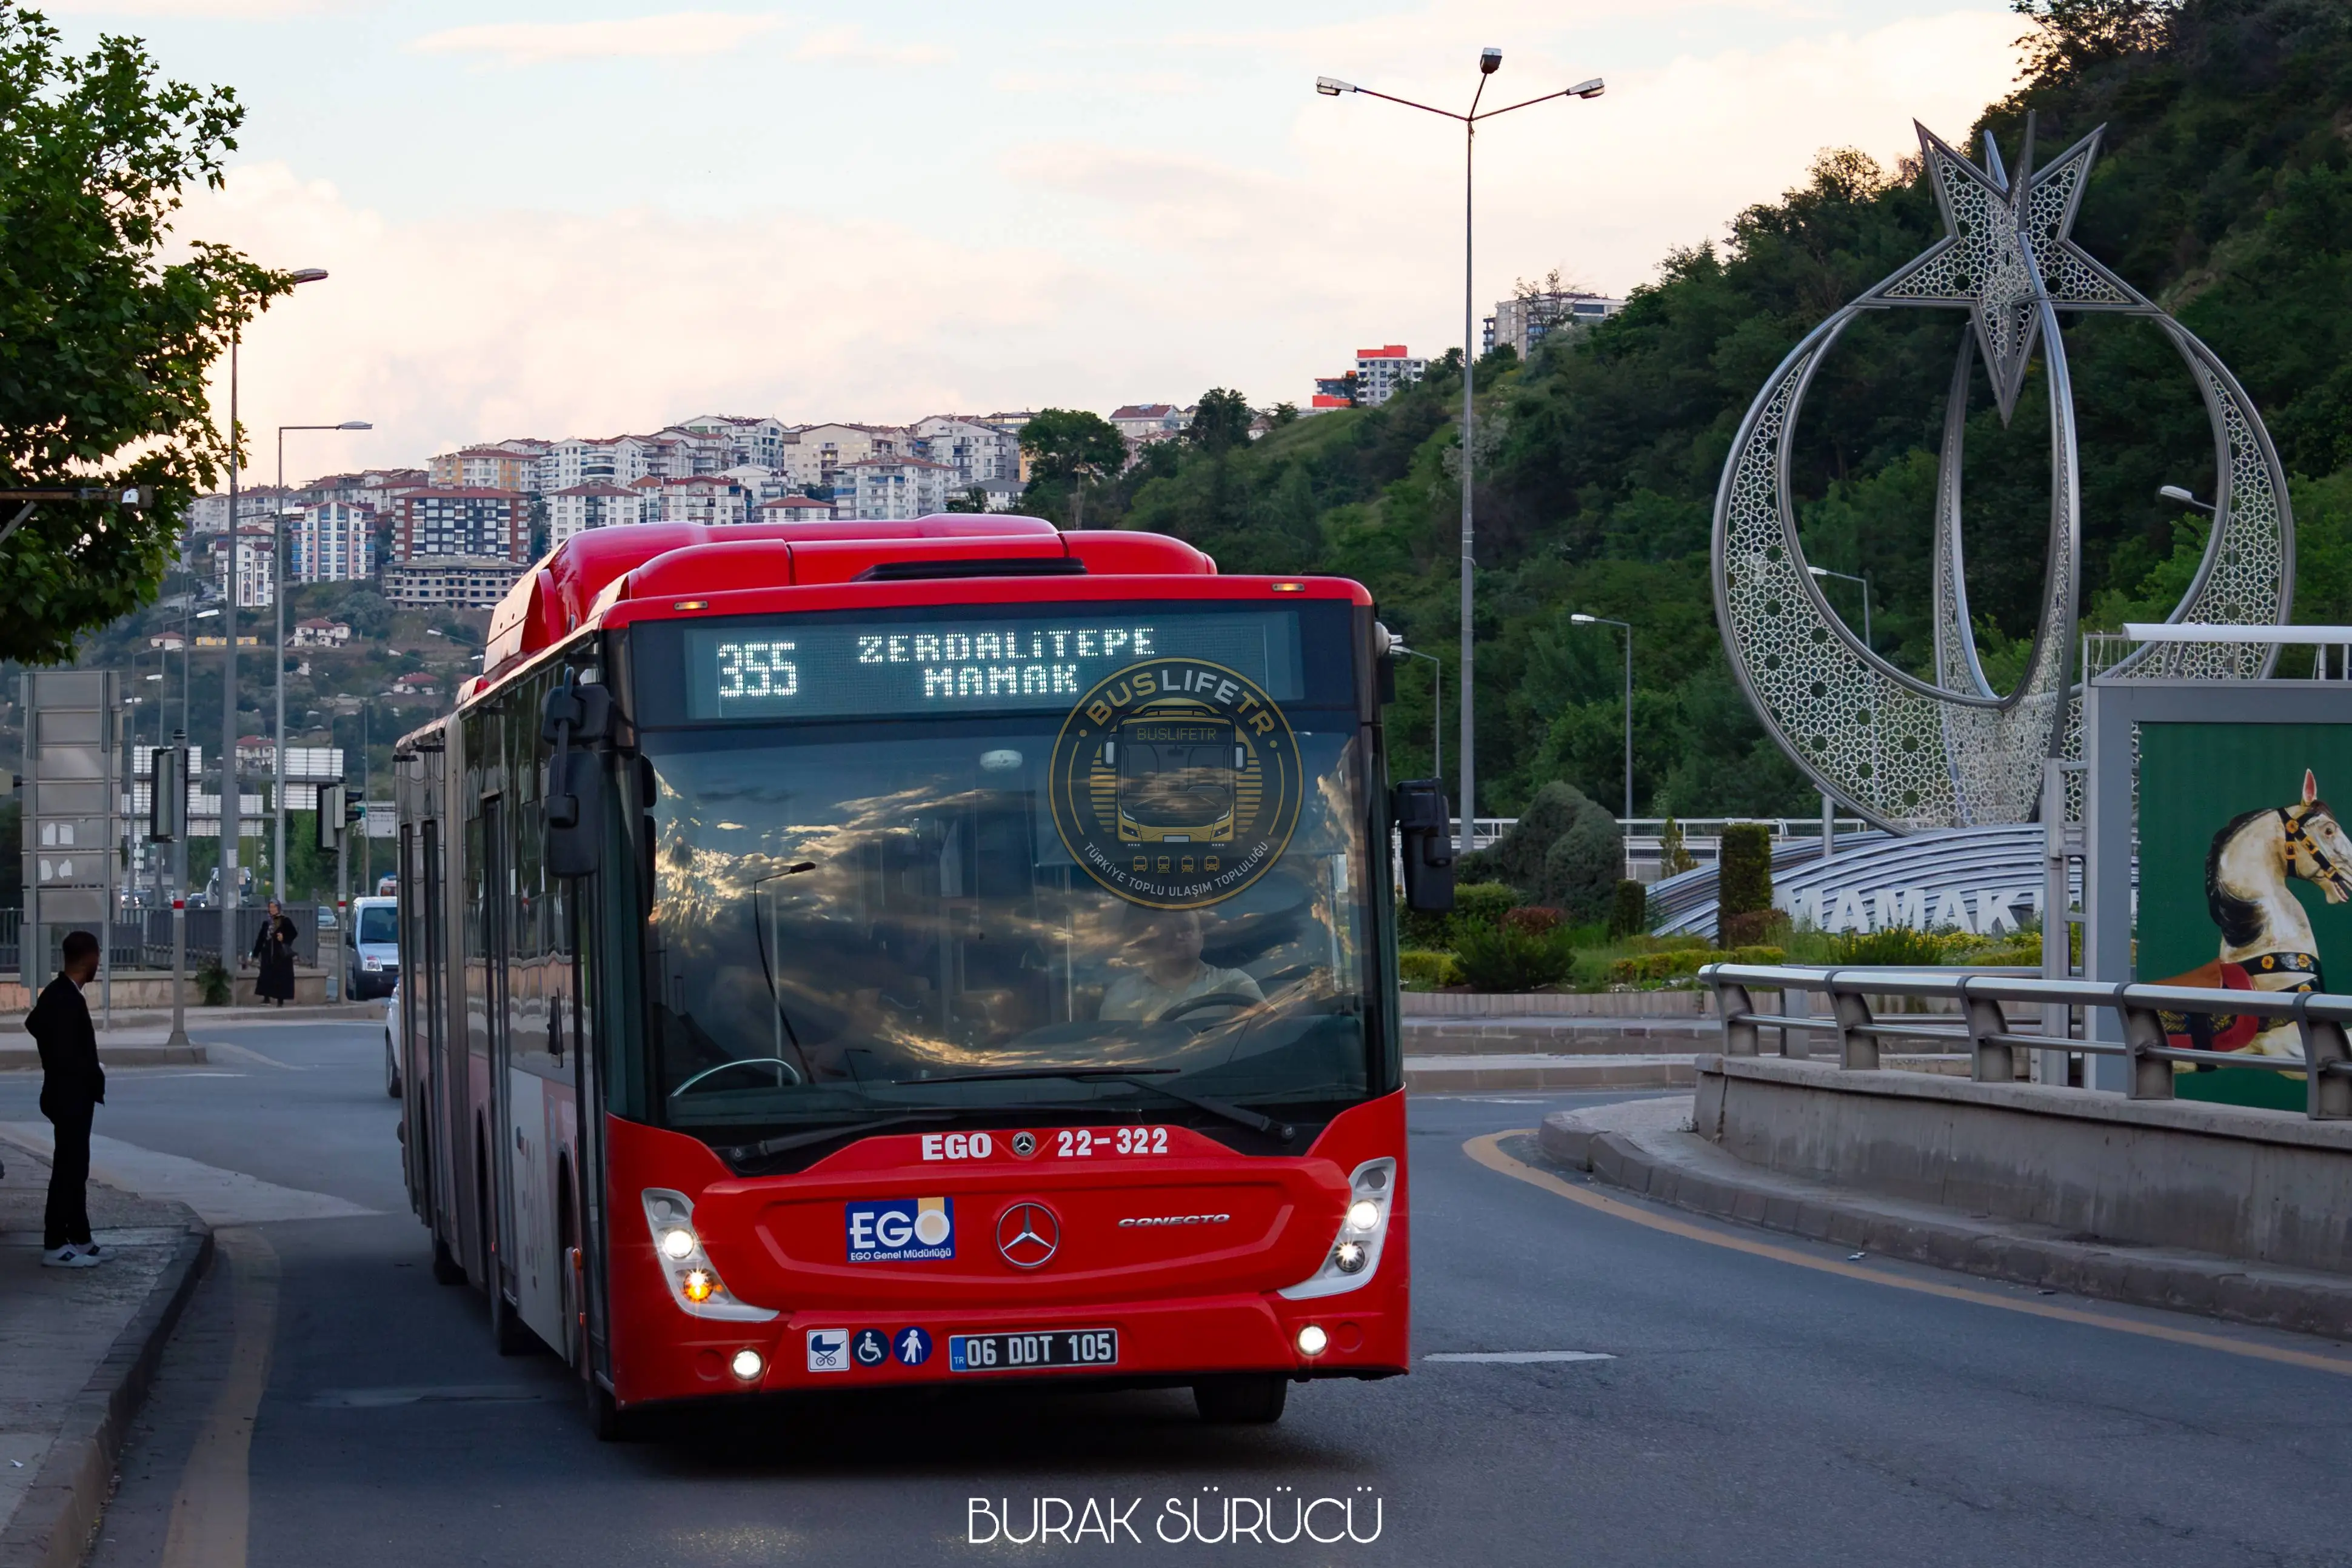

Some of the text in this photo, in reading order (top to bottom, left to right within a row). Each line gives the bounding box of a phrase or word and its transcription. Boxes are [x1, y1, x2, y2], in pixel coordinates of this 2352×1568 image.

[719, 642, 797, 697] 355
[924, 664, 1078, 696] MAMAK
[922, 1133, 992, 1160] EGO
[1058, 1127, 1168, 1157] 22-322
[850, 1209, 950, 1249] EGO
[1118, 1213, 1231, 1227] CONECTO
[850, 1247, 952, 1261] EGO Genel Müdürlüğü
[967, 1333, 1112, 1366] 06 DDT 105
